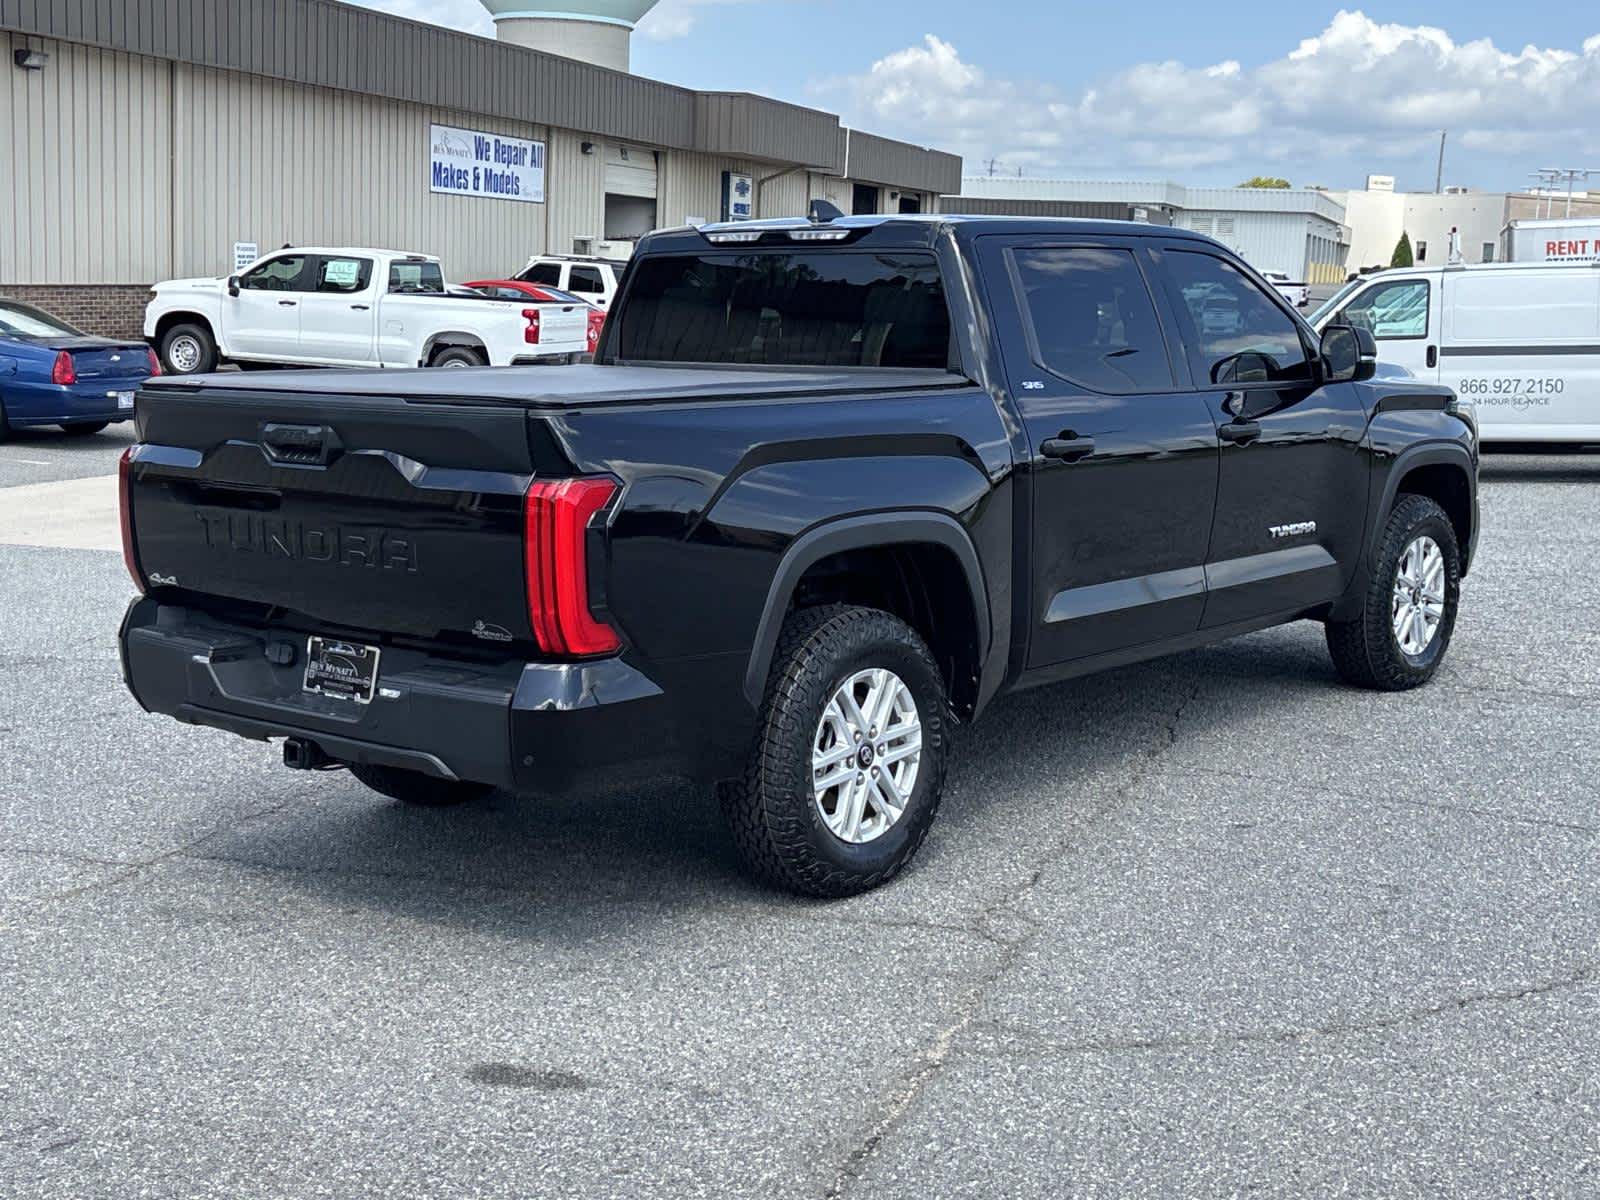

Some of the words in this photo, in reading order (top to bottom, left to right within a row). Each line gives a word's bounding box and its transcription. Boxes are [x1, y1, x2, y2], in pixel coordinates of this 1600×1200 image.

[474, 135, 490, 161] We
[494, 138, 527, 168] Repair
[530, 143, 543, 168] All
[432, 161, 469, 190] Makes
[473, 166, 480, 191] &
[483, 167, 520, 195] Models
[1546, 240, 1589, 256] RENT
[1460, 379, 1564, 394] 866.927.2150
[1473, 398, 1481, 406] 24
[1484, 398, 1510, 406] HOUR
[1268, 520, 1316, 538] TUNDRA
[194, 510, 418, 572] TUNDRA
